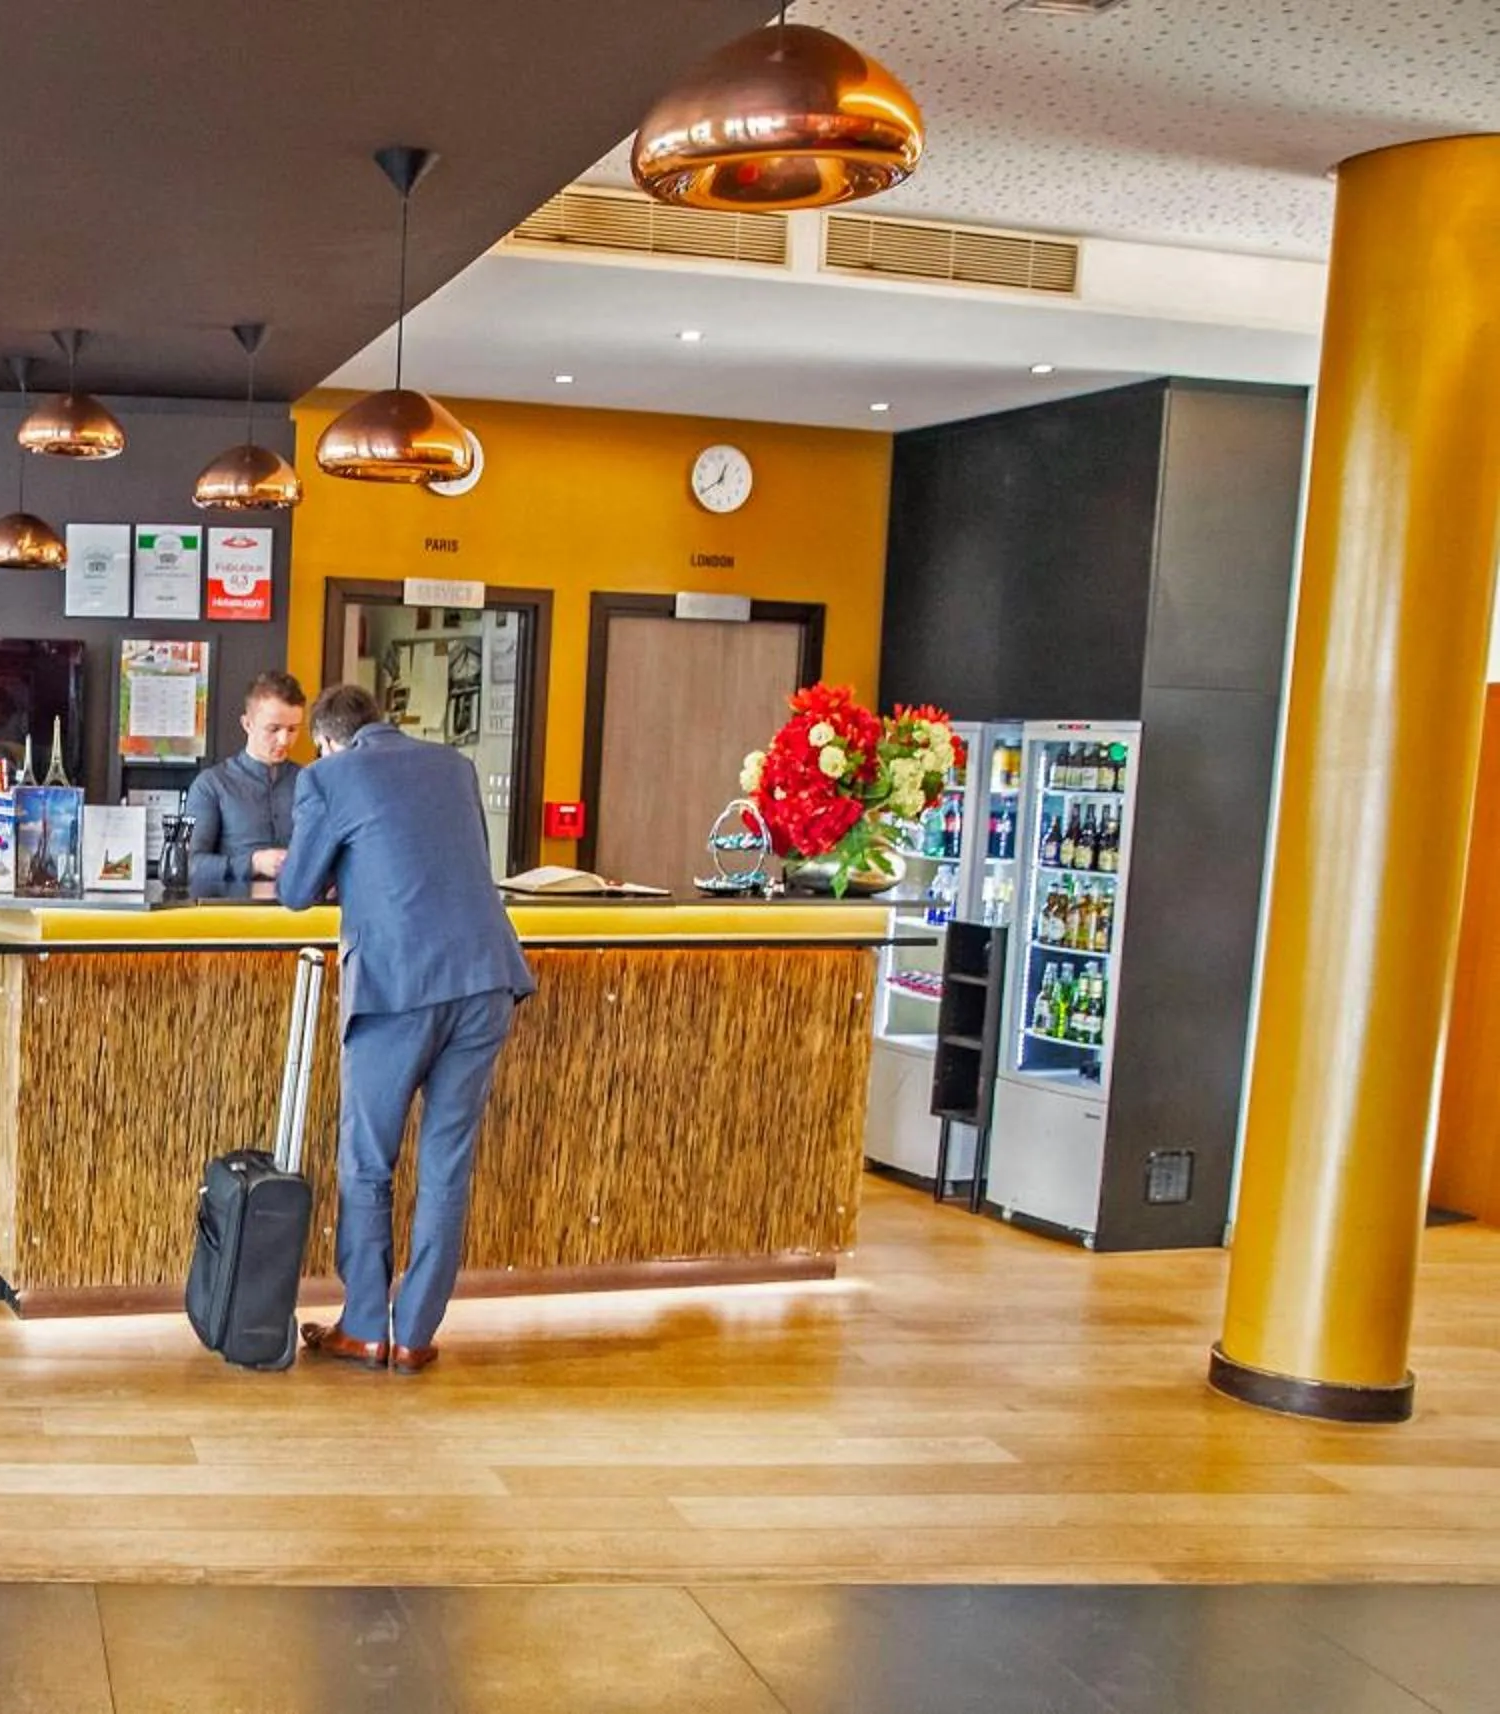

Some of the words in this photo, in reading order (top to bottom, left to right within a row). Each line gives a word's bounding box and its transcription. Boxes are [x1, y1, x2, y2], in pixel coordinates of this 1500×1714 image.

[425, 538, 458, 552] PARIS
[691, 554, 734, 567] LONDON
[417, 584, 472, 602] SERVICE
